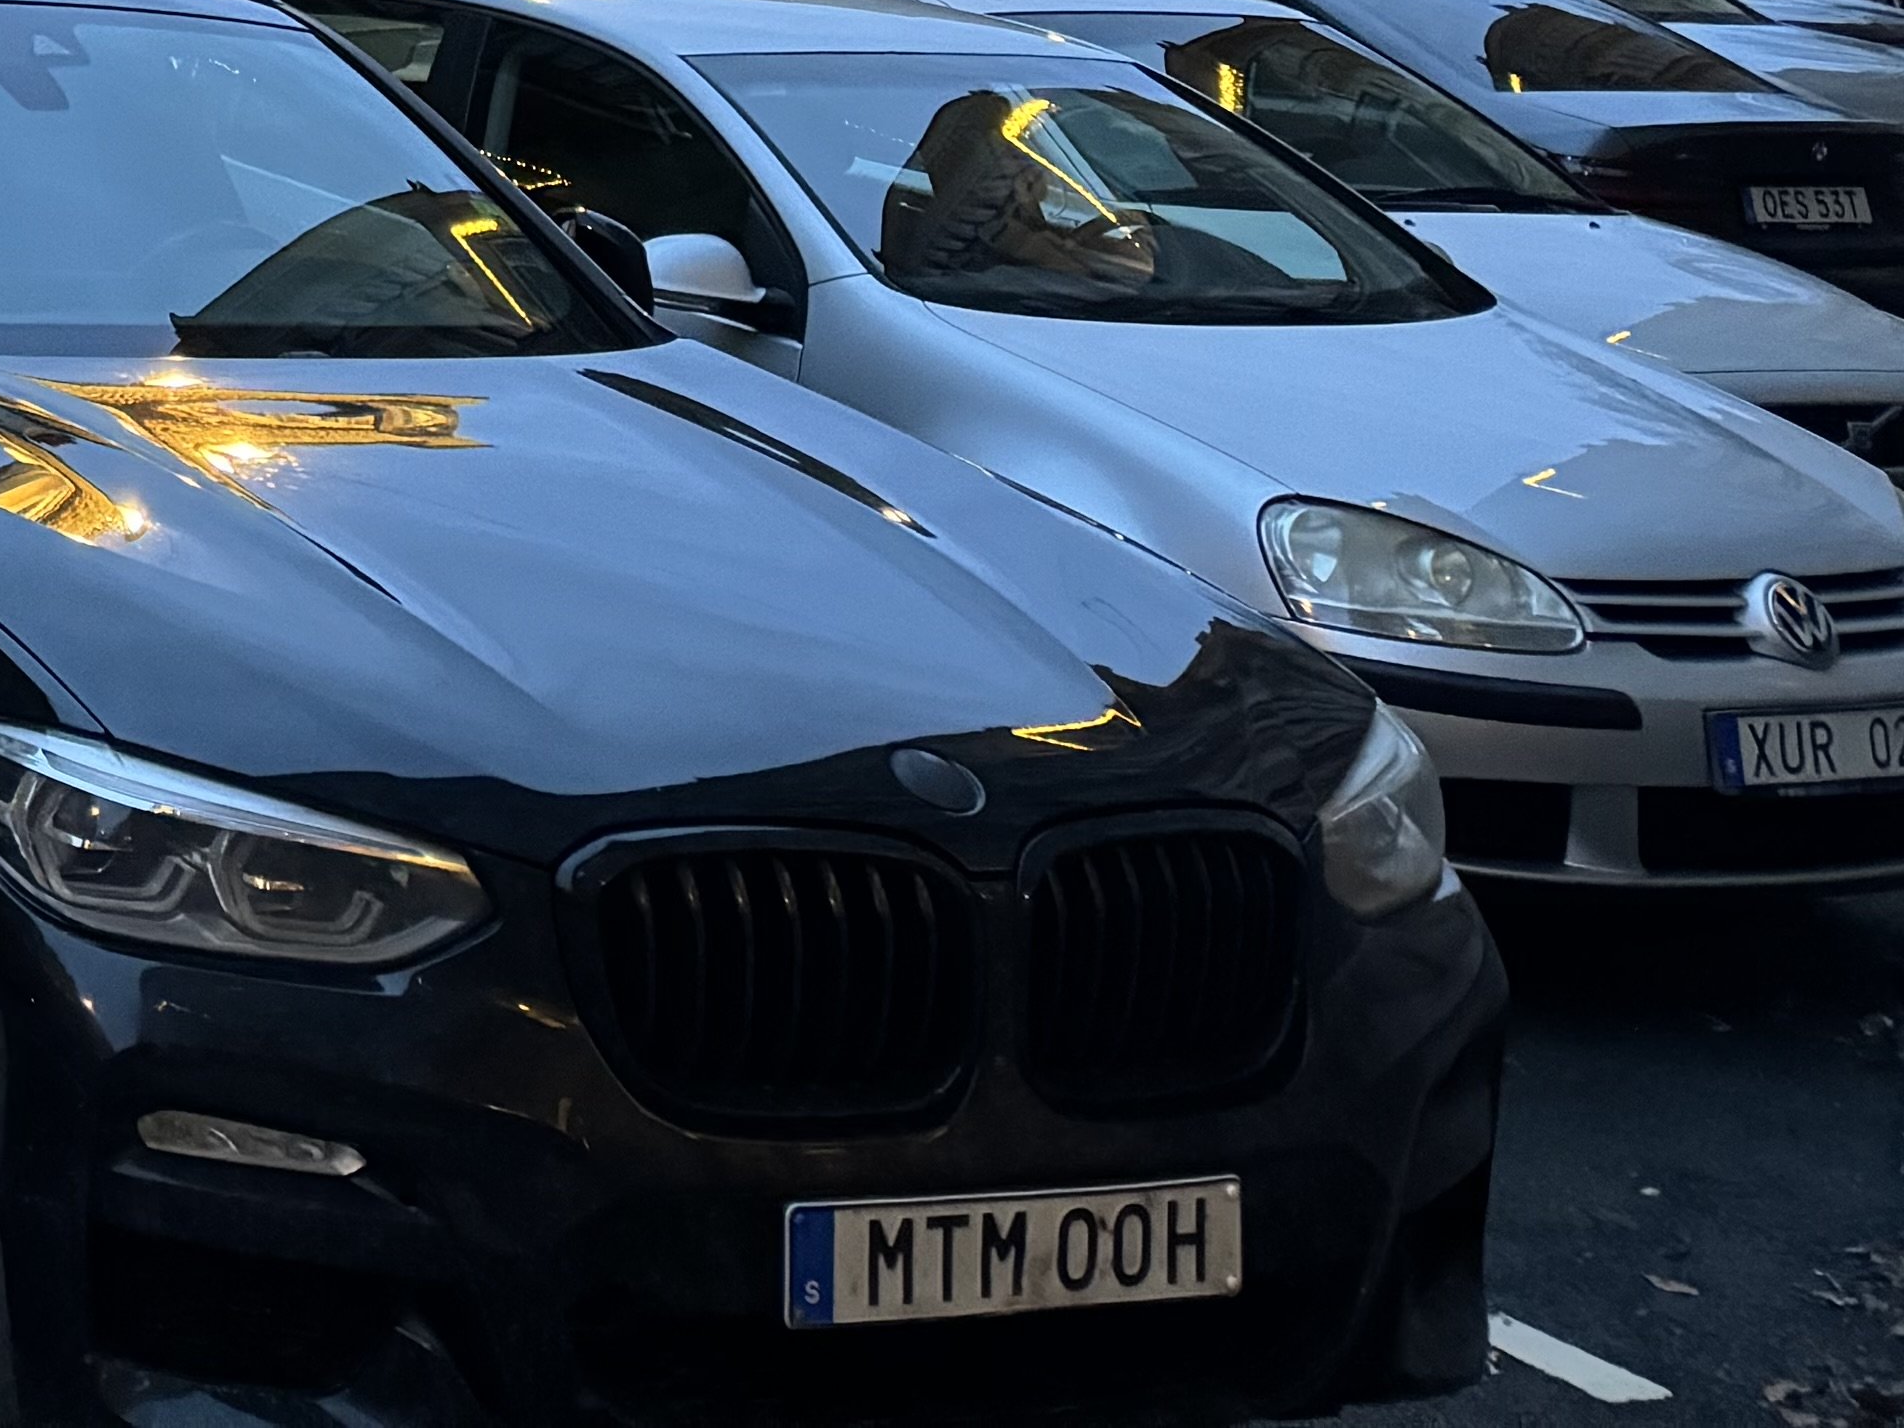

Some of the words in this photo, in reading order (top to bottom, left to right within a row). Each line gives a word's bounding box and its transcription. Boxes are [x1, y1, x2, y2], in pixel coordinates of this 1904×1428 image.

[1762, 190, 1809, 219] OES
[1748, 720, 1836, 778] XUR
[868, 1211, 1028, 1307] MTM
[804, 1280, 820, 1304] S
